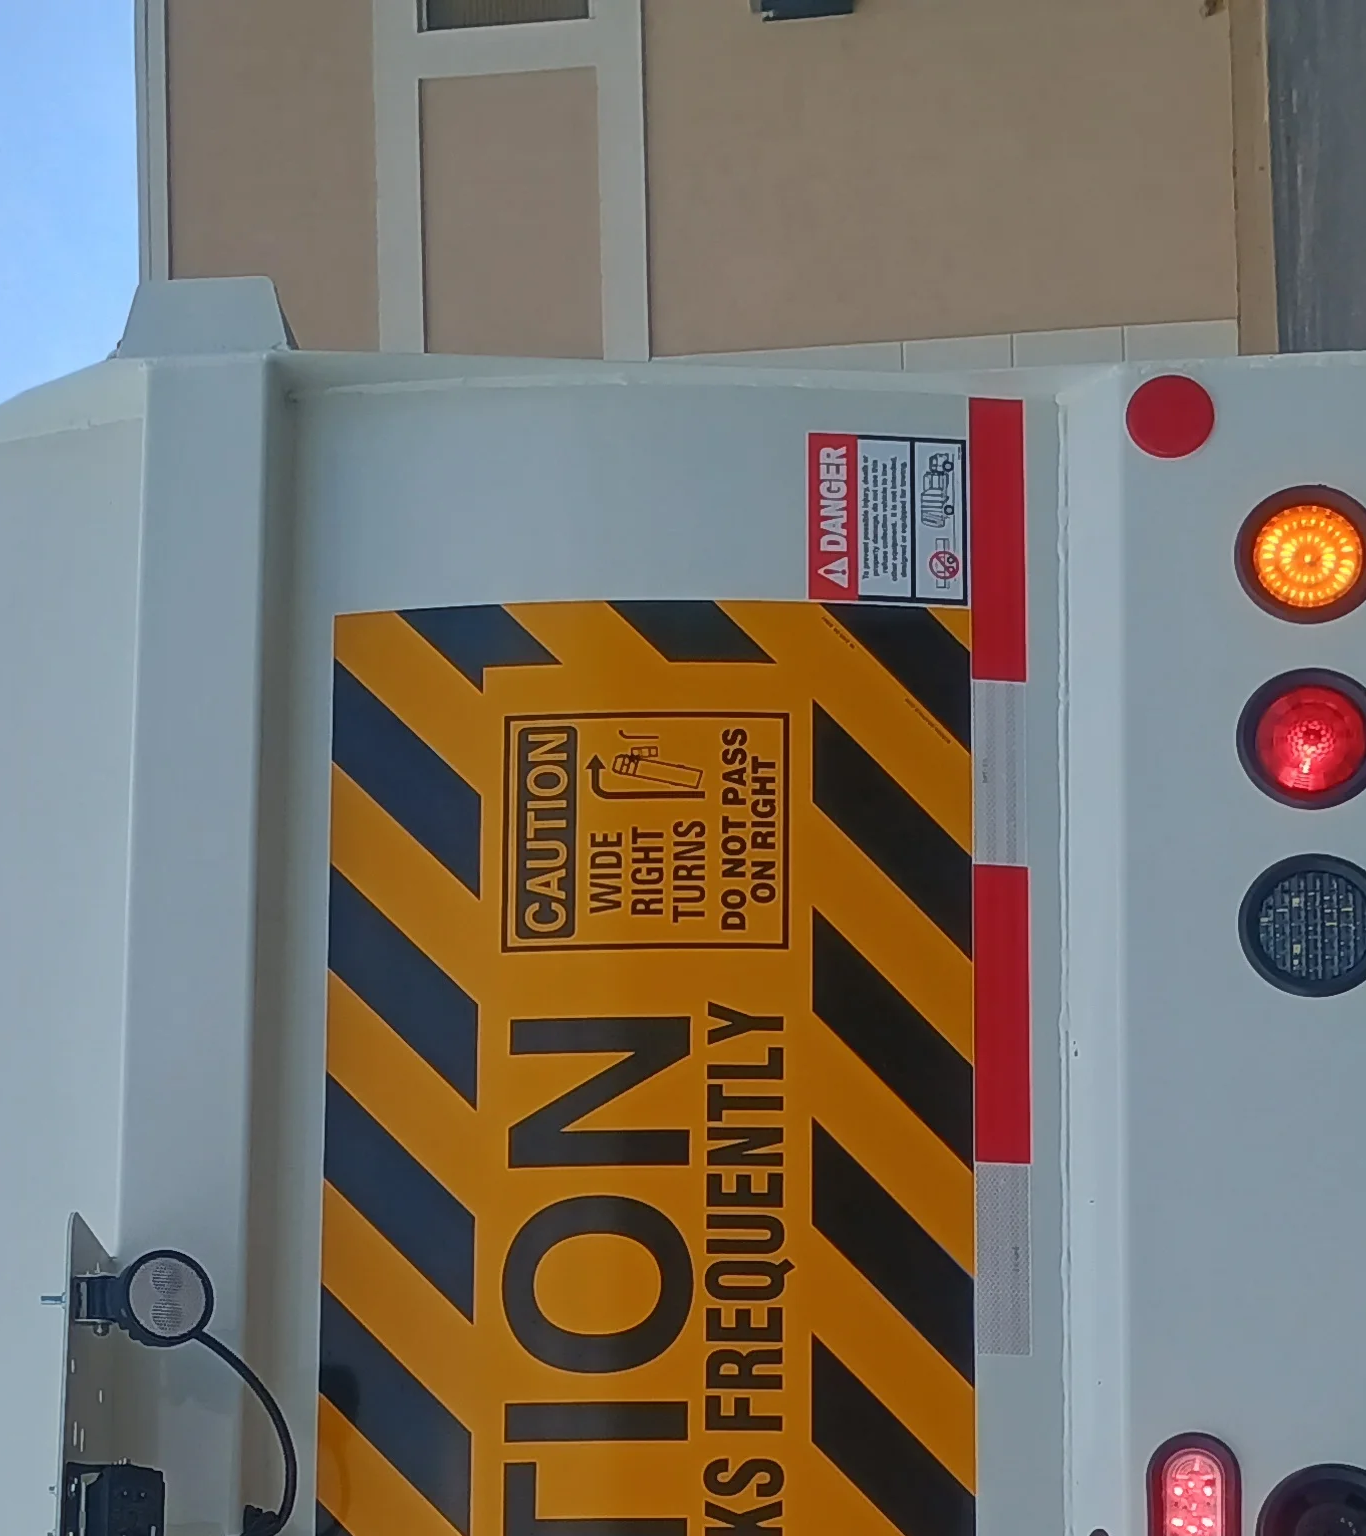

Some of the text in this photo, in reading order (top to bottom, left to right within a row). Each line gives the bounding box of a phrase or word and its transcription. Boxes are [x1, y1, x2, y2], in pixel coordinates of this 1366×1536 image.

[819, 445, 848, 552] DANGER
[524, 733, 568, 932] CAUTION
[589, 832, 623, 915] WIDE
[631, 826, 664, 916] RIGHT
[672, 820, 706, 924] TURNS
[720, 728, 747, 931] DO NOT PASS
[751, 756, 776, 904] ON RIGHT
[705, 1001, 796, 1432] FREQUENTLY
